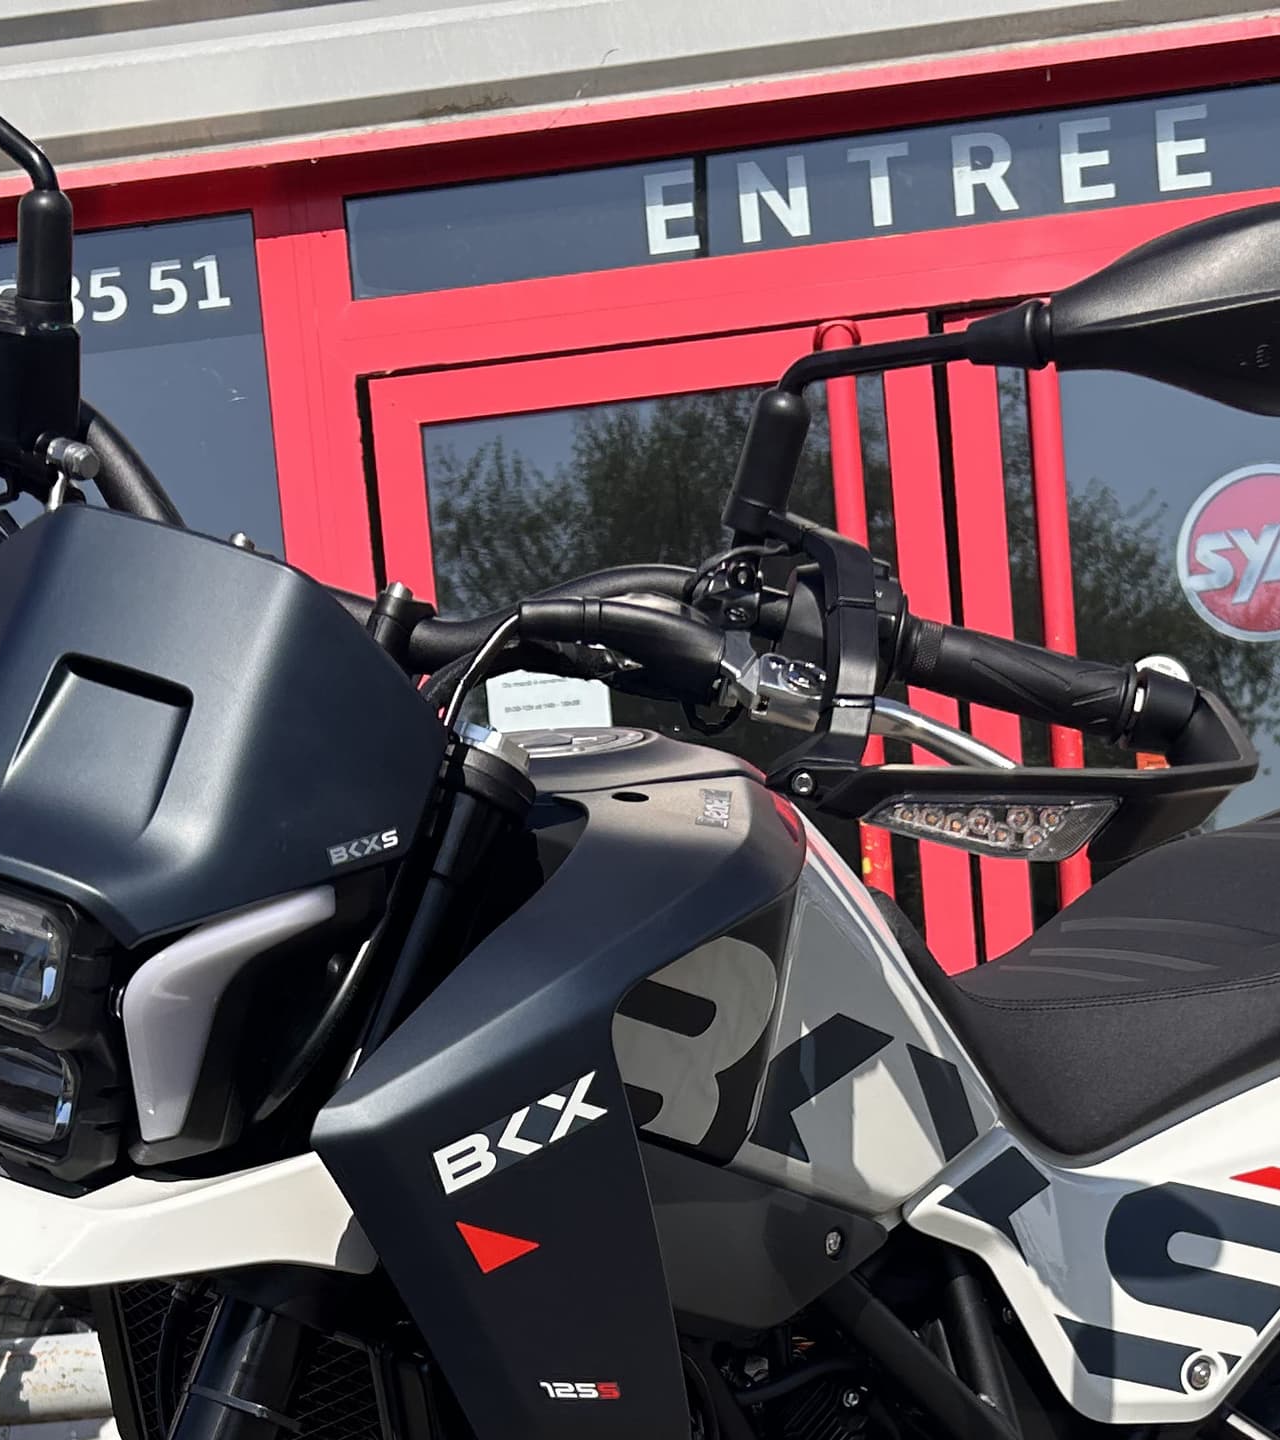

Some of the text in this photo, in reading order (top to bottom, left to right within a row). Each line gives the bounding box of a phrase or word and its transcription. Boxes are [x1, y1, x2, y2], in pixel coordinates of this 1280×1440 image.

[643, 104, 1213, 256] ENTREE
[149, 254, 232, 315] 51
[539, 1381, 621, 1399] 125S
